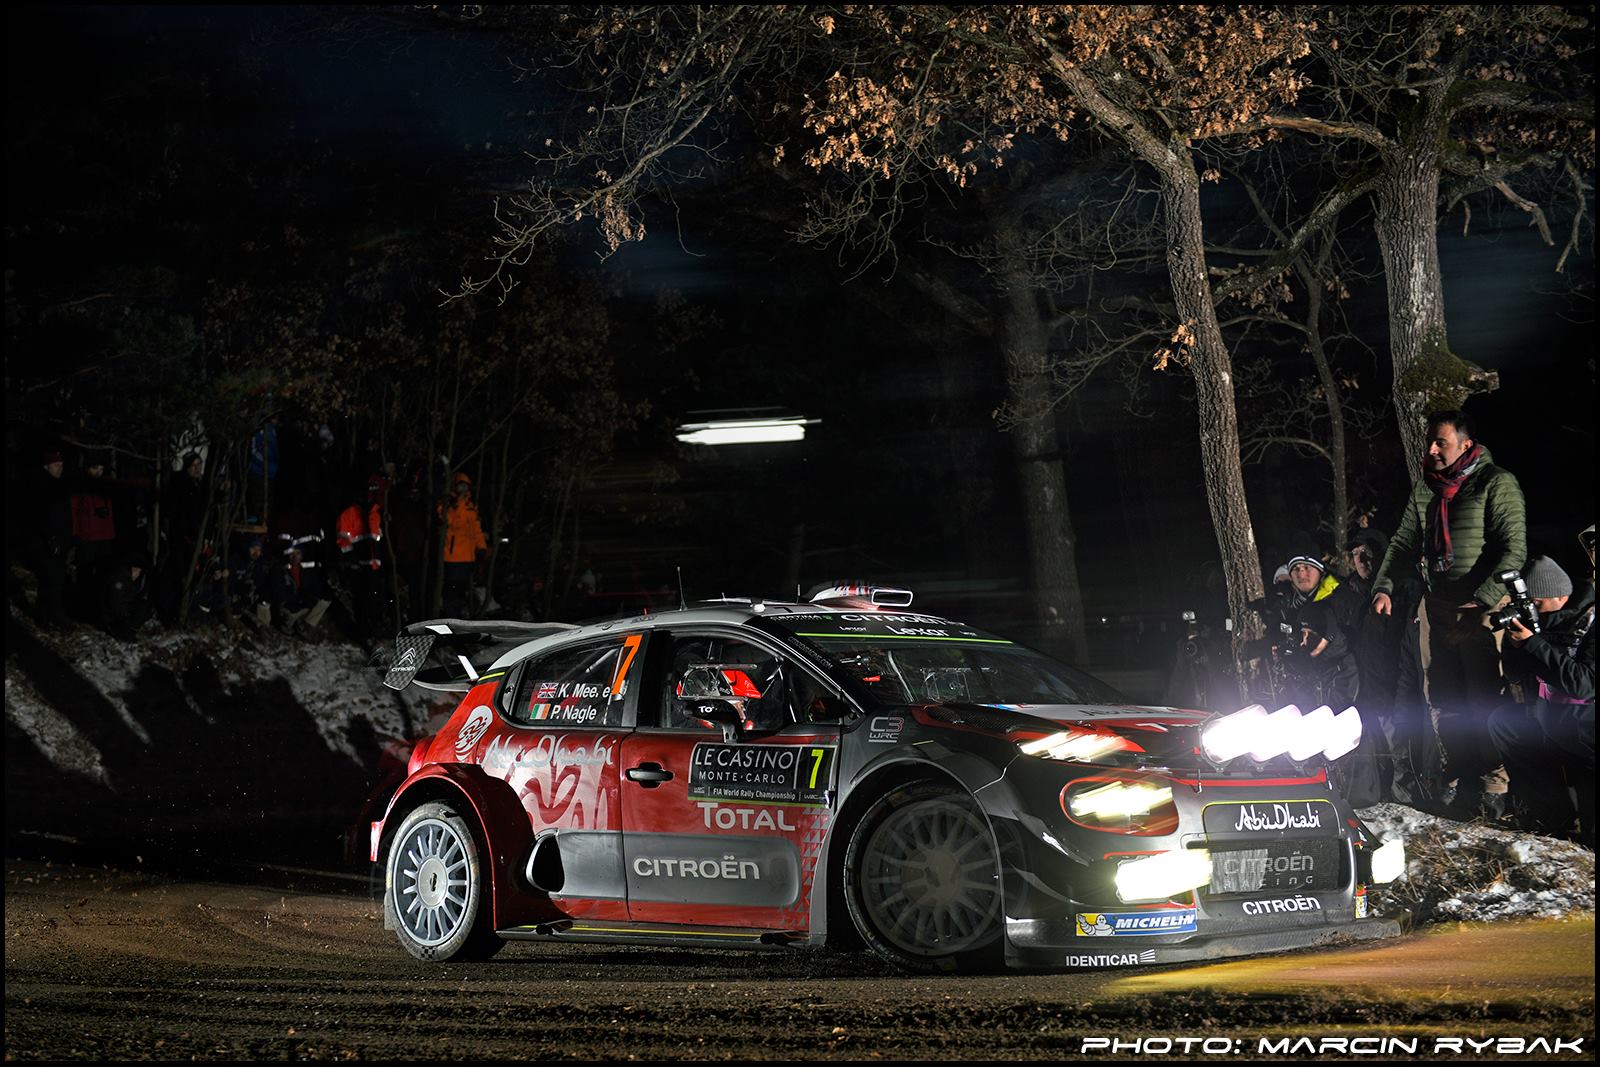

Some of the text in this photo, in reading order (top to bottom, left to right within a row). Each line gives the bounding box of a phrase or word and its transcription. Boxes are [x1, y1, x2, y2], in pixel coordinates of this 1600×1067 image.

[886, 625, 950, 637] Lexar
[611, 634, 643, 695] 7
[558, 683, 612, 698] K. Meee
[550, 705, 598, 724] P. Nagle
[870, 716, 905, 732] C3
[694, 747, 794, 770] LE CASINO
[809, 749, 824, 789] 7
[712, 786, 796, 801] FIA World Rally Championship
[697, 802, 796, 832] TOTAL
[1115, 914, 1195, 929] MICHELIN
[1065, 953, 1139, 967] IDENTICAR
